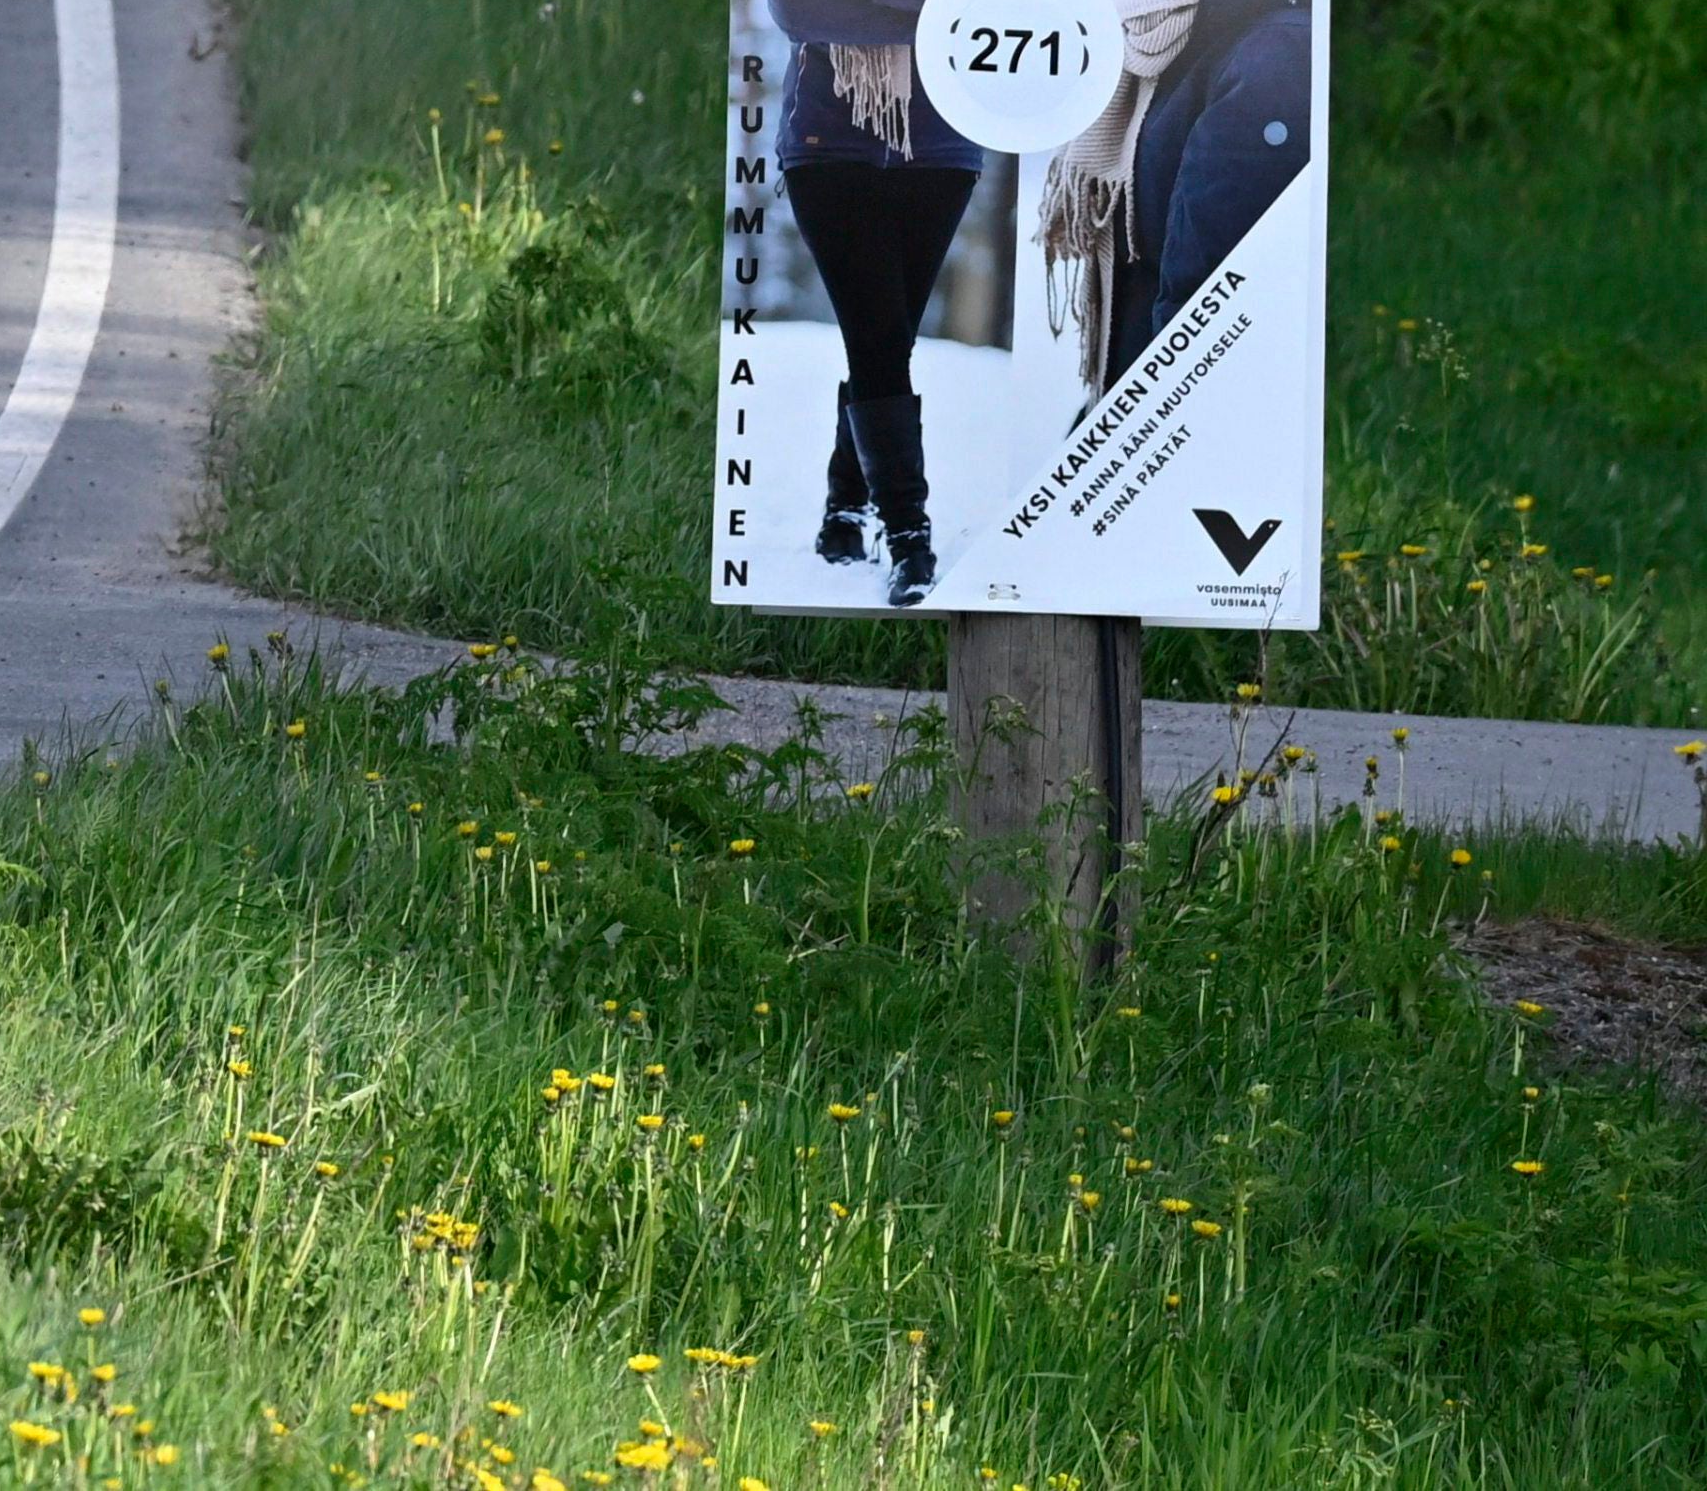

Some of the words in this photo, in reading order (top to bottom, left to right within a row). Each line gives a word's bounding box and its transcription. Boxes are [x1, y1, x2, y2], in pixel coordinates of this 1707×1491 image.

[723, 55, 768, 588] RUMMUKAINEN
[1002, 486, 1057, 541] YKSI
[1050, 379, 1149, 488] KAIKKIEN
[1143, 269, 1247, 382] PUOLESTA
[1070, 458, 1125, 517] #ANNA
[1119, 417, 1159, 461] ÄÄNI
[1155, 312, 1254, 420] MUUTOKSELLE
[1091, 481, 1141, 537] #SINÄ
[1136, 423, 1193, 486] PÄÄTÄT
[1196, 583, 1282, 596] vasemmisto
[1210, 597, 1267, 608] UUSIMAA
